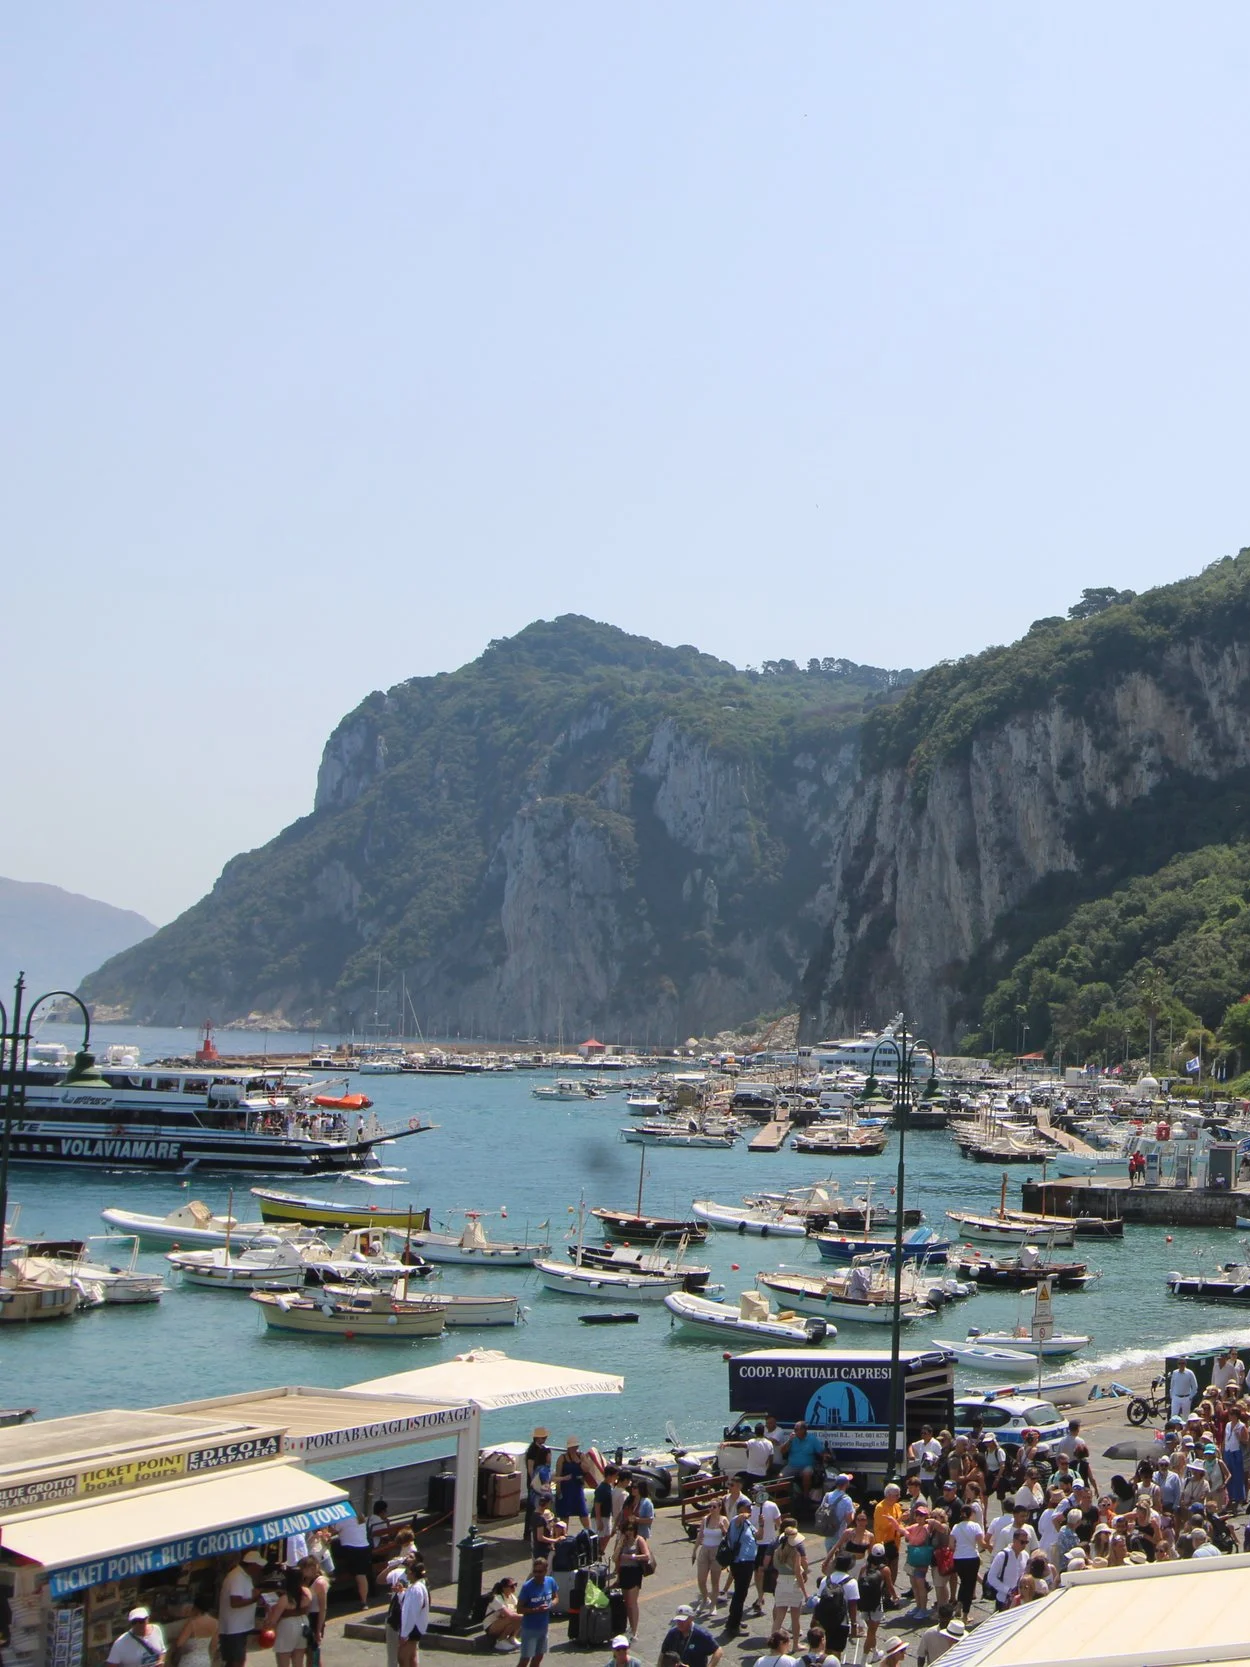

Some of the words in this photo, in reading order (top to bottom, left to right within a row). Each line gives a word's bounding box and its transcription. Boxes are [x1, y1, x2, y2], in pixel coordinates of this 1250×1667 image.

[60, 1139, 181, 1159] VOLAVIAMARE
[739, 1366, 775, 1378] COOP.
[777, 1366, 838, 1379] PORTUALI
[493, 1386, 567, 1406] PORTABAGAGLI
[571, 1381, 612, 1394] STORAGE
[306, 1420, 410, 1450] PORTABAGAGLI
[413, 1407, 471, 1429] STORAGE
[189, 1446, 277, 1471] NEWSPAPERS
[190, 1437, 278, 1463] EDICOLA
[82, 1464, 131, 1482] TICKET
[137, 1454, 184, 1472] POINT
[84, 1476, 124, 1493] boat
[134, 1466, 177, 1484] tours
[0, 1487, 25, 1500] LUE
[27, 1477, 75, 1494] GROTTO
[0, 1494, 39, 1509] SLAND
[41, 1487, 74, 1501] TOUR
[54, 1563, 104, 1592] TICKET
[108, 1553, 153, 1579] POINT
[199, 1527, 255, 1557] GROTTO
[263, 1513, 310, 1541] ISLAND
[310, 1503, 350, 1526] TOUR
